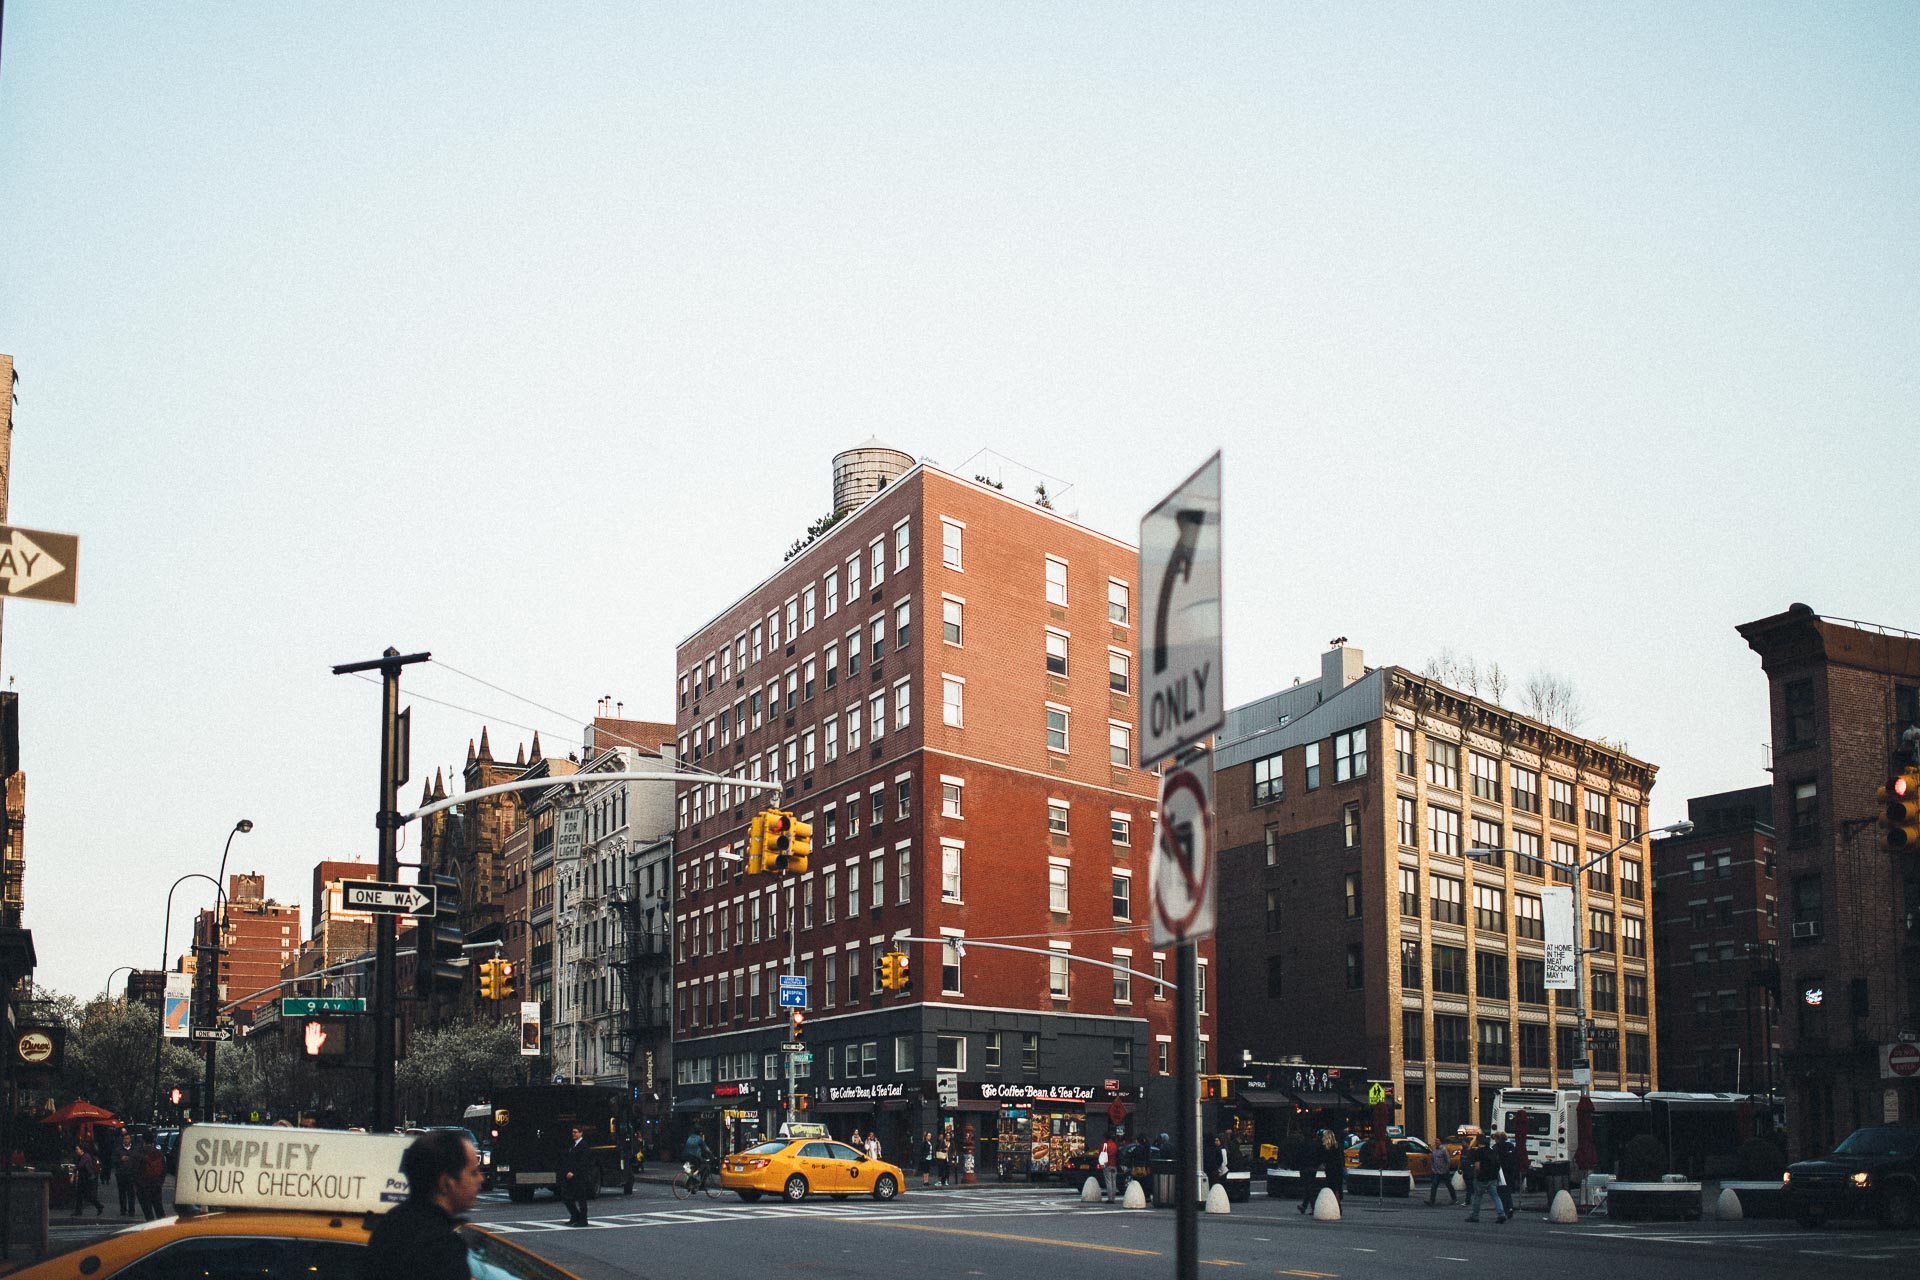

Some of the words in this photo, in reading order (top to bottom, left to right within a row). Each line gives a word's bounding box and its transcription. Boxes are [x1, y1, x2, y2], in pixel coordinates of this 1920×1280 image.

[1150, 660, 1210, 738] ONLY
[565, 811, 580, 820] WAIT
[564, 822, 577, 832] FOR
[560, 834, 581, 844] GREEN
[559, 846, 578, 856] LIGHT
[356, 891, 382, 903] ONE
[395, 894, 421, 906] WAY
[307, 1001, 316, 1012] 9
[323, 1002, 341, 1010] Av
[830, 1087, 839, 1100] The
[840, 1087, 855, 1099] Coffee
[871, 1085, 876, 1097] &
[877, 1084, 887, 1096] Tea
[887, 1083, 904, 1096] Leaf
[981, 1083, 997, 1098] The
[998, 1084, 1024, 1097] Coffee
[1050, 1086, 1057, 1098] &
[1058, 1086, 1073, 1098] Tea
[1073, 1087, 1094, 1099] Leaf
[497, 1114, 508, 1124] ups
[194, 1138, 320, 1170] SIMPLIFY
[193, 1169, 245, 1194] YOUR
[257, 1171, 367, 1200] CHECKOUT
